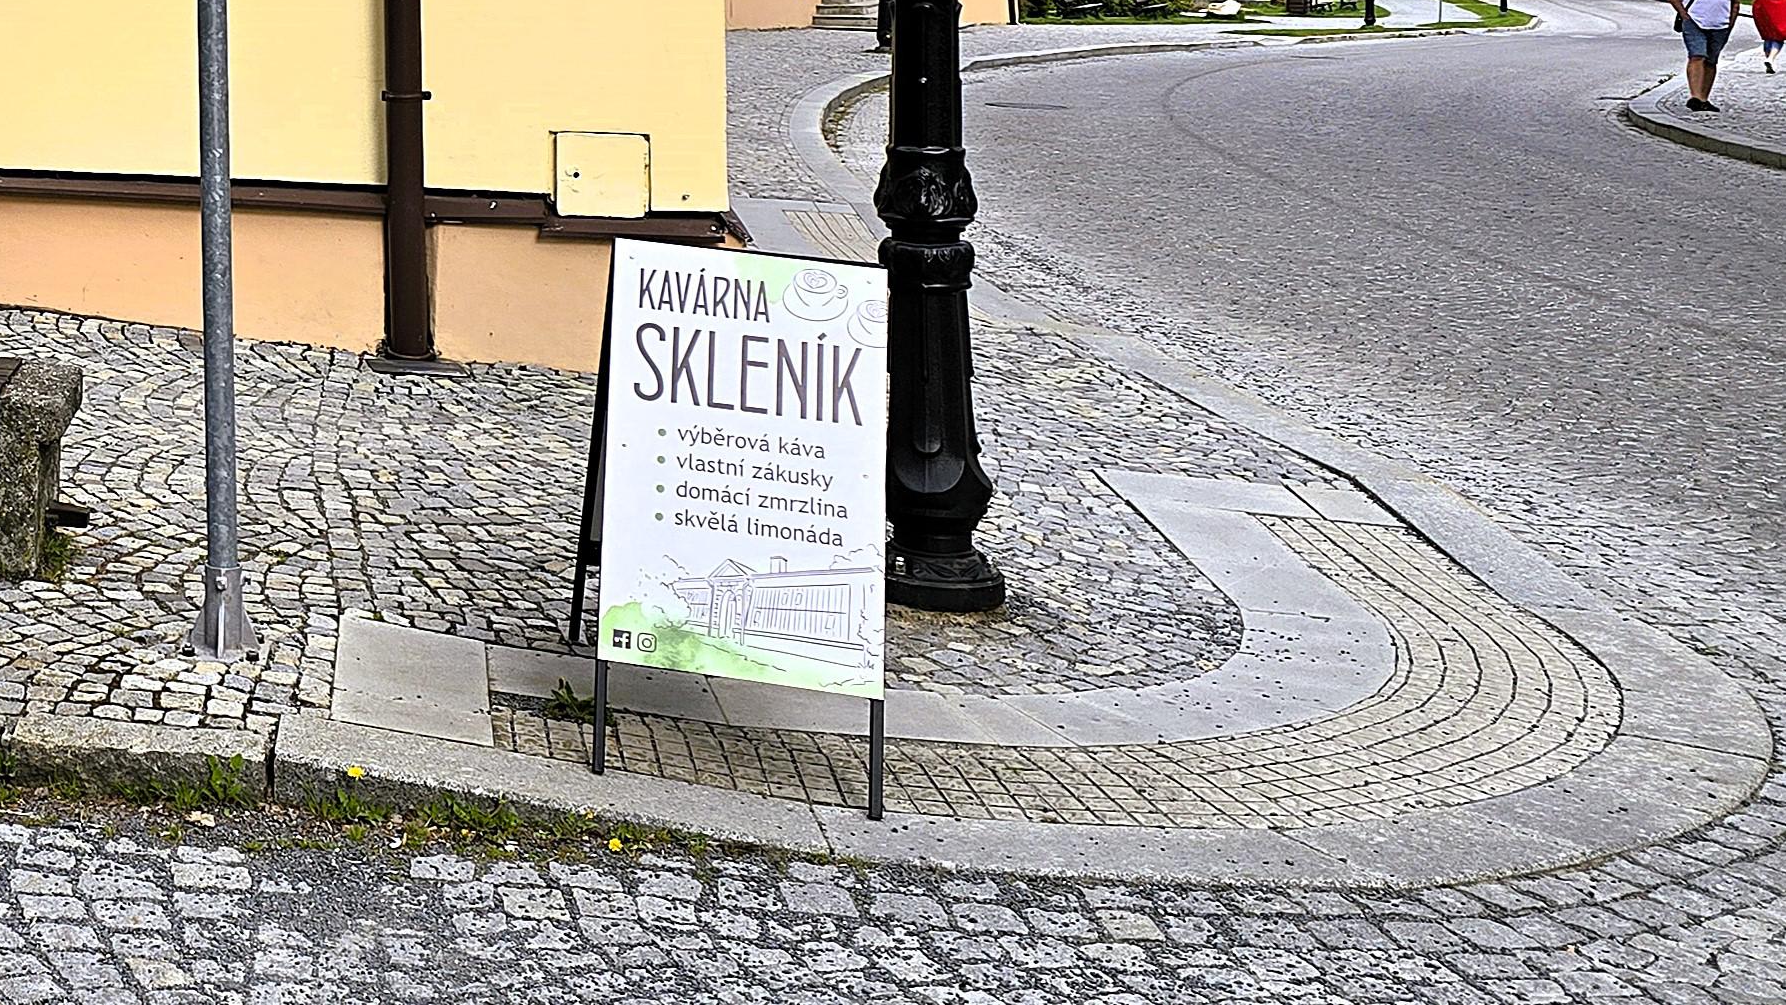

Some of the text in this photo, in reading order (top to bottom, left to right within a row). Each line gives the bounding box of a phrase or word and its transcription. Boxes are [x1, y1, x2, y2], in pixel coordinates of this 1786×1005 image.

[639, 267, 770, 323] KAVÁRNA
[634, 322, 863, 426] SKLENÍK
[677, 425, 825, 459] výběrová káva
[677, 453, 834, 492] vlastní zákusky
[676, 481, 848, 519] domácí zmrzlina
[674, 509, 844, 547] skvělá limonáda
